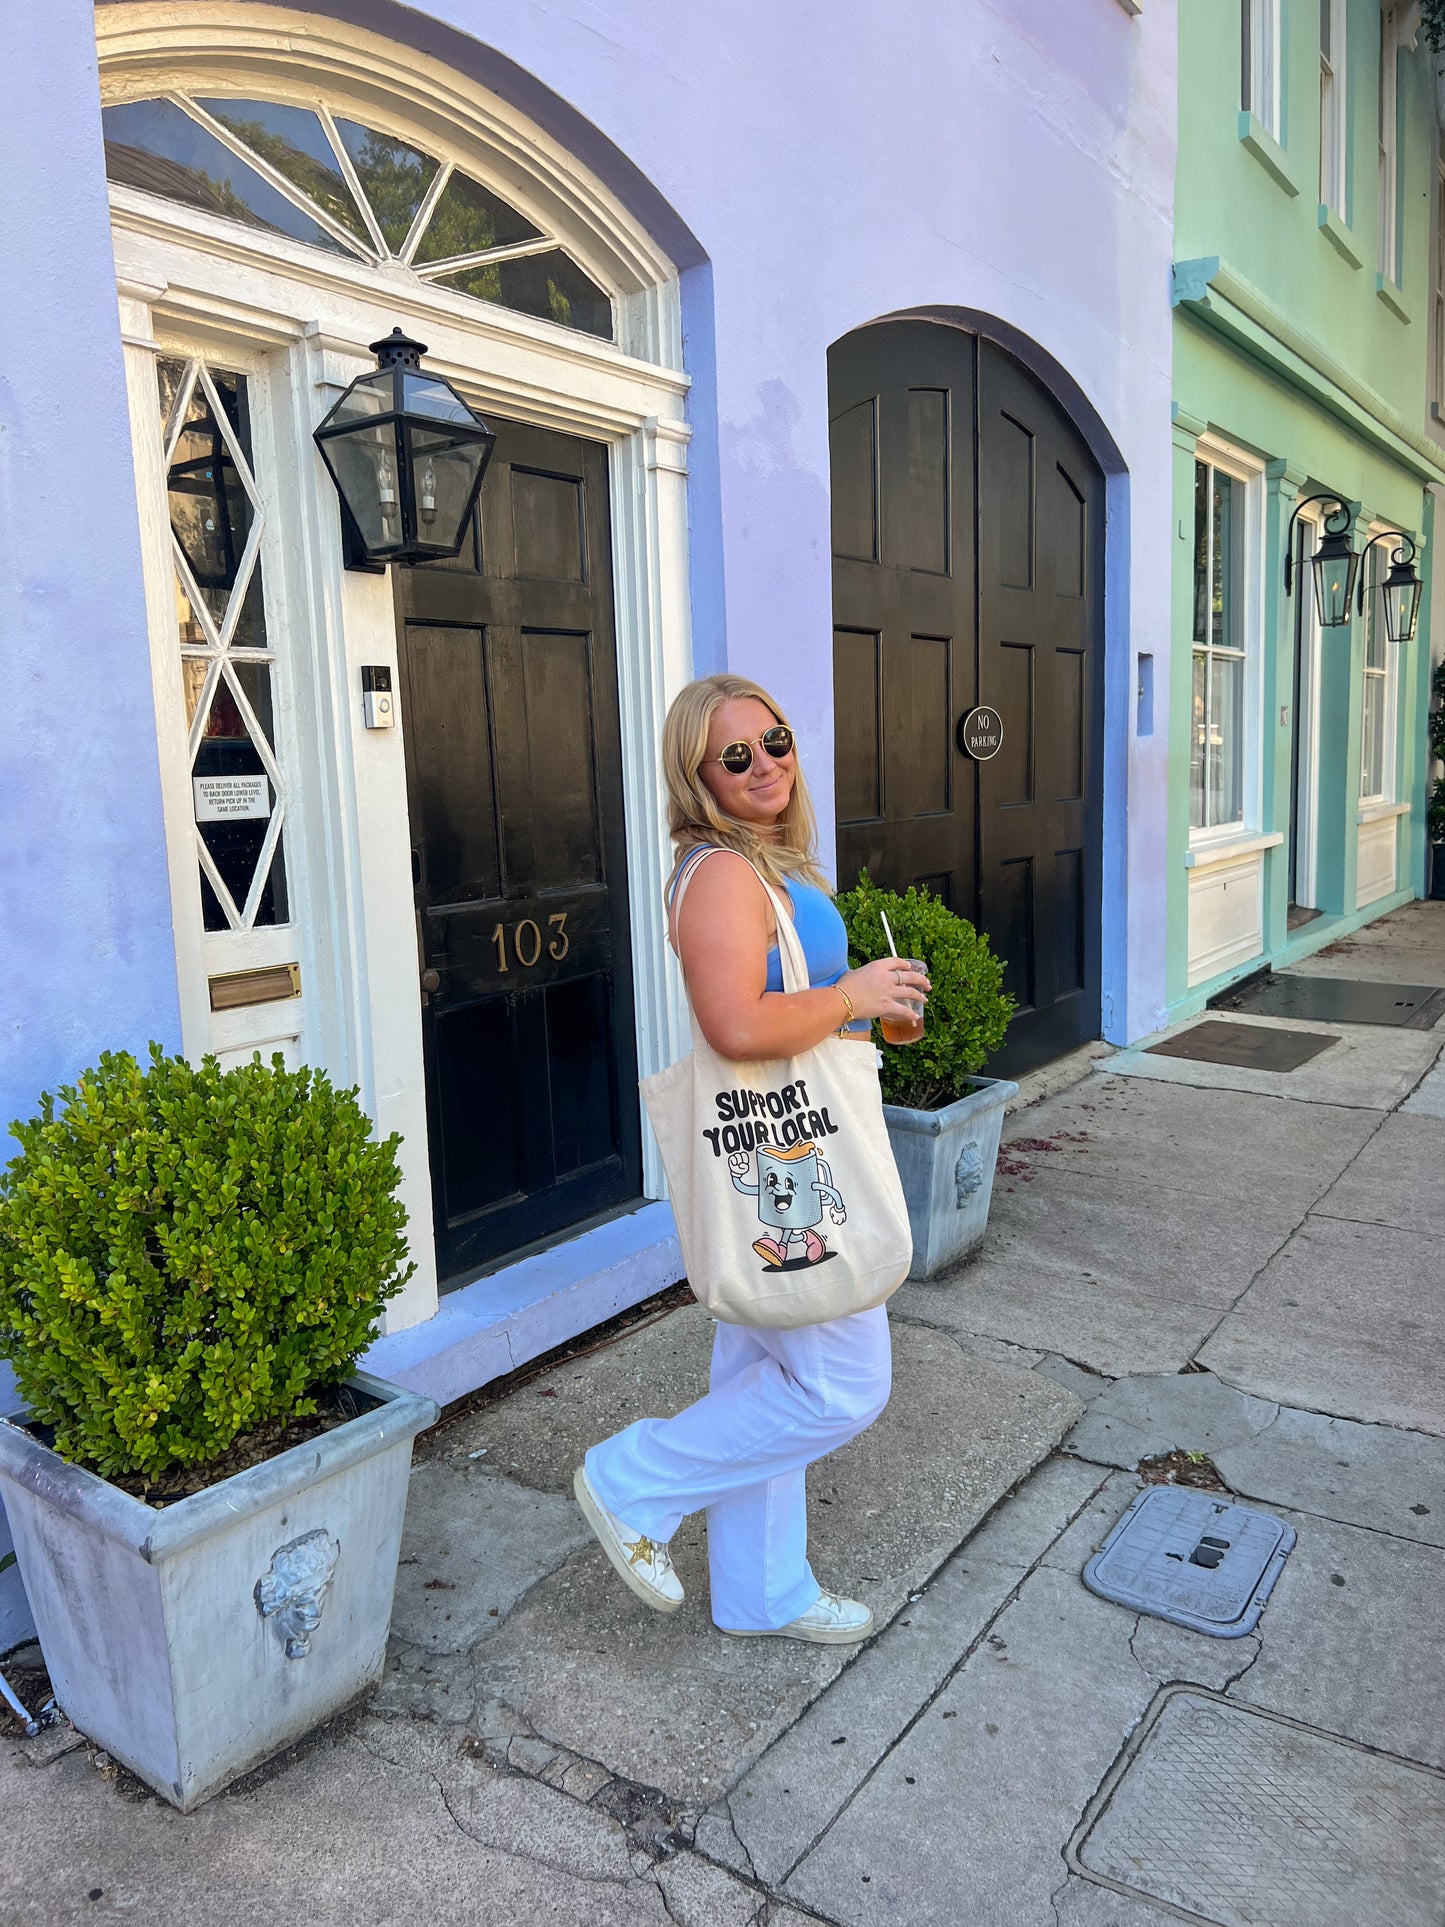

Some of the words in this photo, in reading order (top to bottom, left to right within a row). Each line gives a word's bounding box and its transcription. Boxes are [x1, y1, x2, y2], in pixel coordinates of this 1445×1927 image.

[970, 735, 997, 748] PARKING
[977, 714, 990, 730] NO
[491, 912, 570, 973] 103
[715, 1080, 810, 1121] SUPPORT
[703, 1121, 770, 1157] YOUR
[771, 1107, 839, 1147] LOCAL
